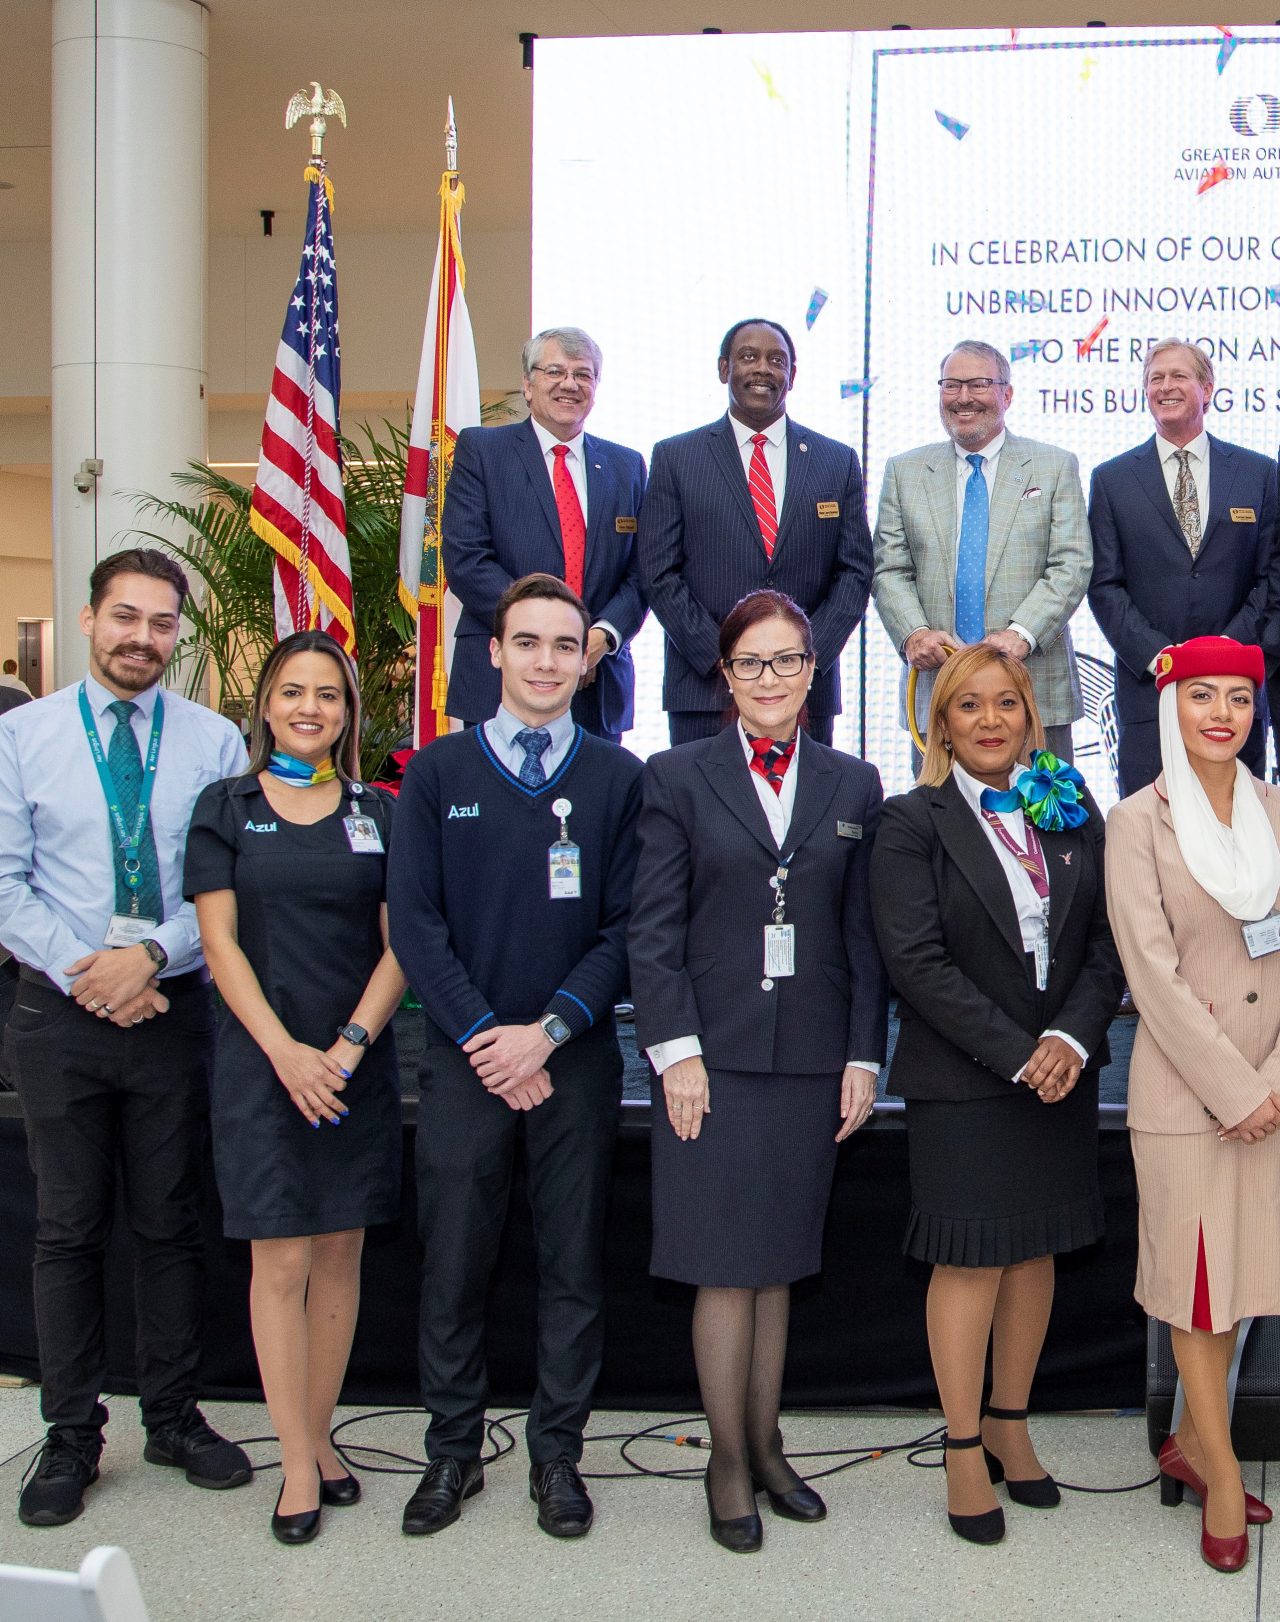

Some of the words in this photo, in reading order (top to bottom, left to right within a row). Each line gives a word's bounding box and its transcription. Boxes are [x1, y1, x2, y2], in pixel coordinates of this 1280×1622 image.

[1181, 147, 1250, 162] GREATER
[1174, 166, 1247, 181] AVIATON
[932, 242, 958, 266] IN
[969, 237, 1147, 265] CELEBRATION
[1156, 236, 1192, 262] OF
[1201, 236, 1261, 262] OUR
[946, 288, 1093, 315] UNBRIDLED
[1029, 338, 1064, 363] TO
[1072, 338, 1119, 363] THE
[1039, 388, 1093, 414] THIS
[1244, 388, 1266, 413] IS
[448, 802, 480, 819] Azul
[244, 820, 278, 833] Azul
